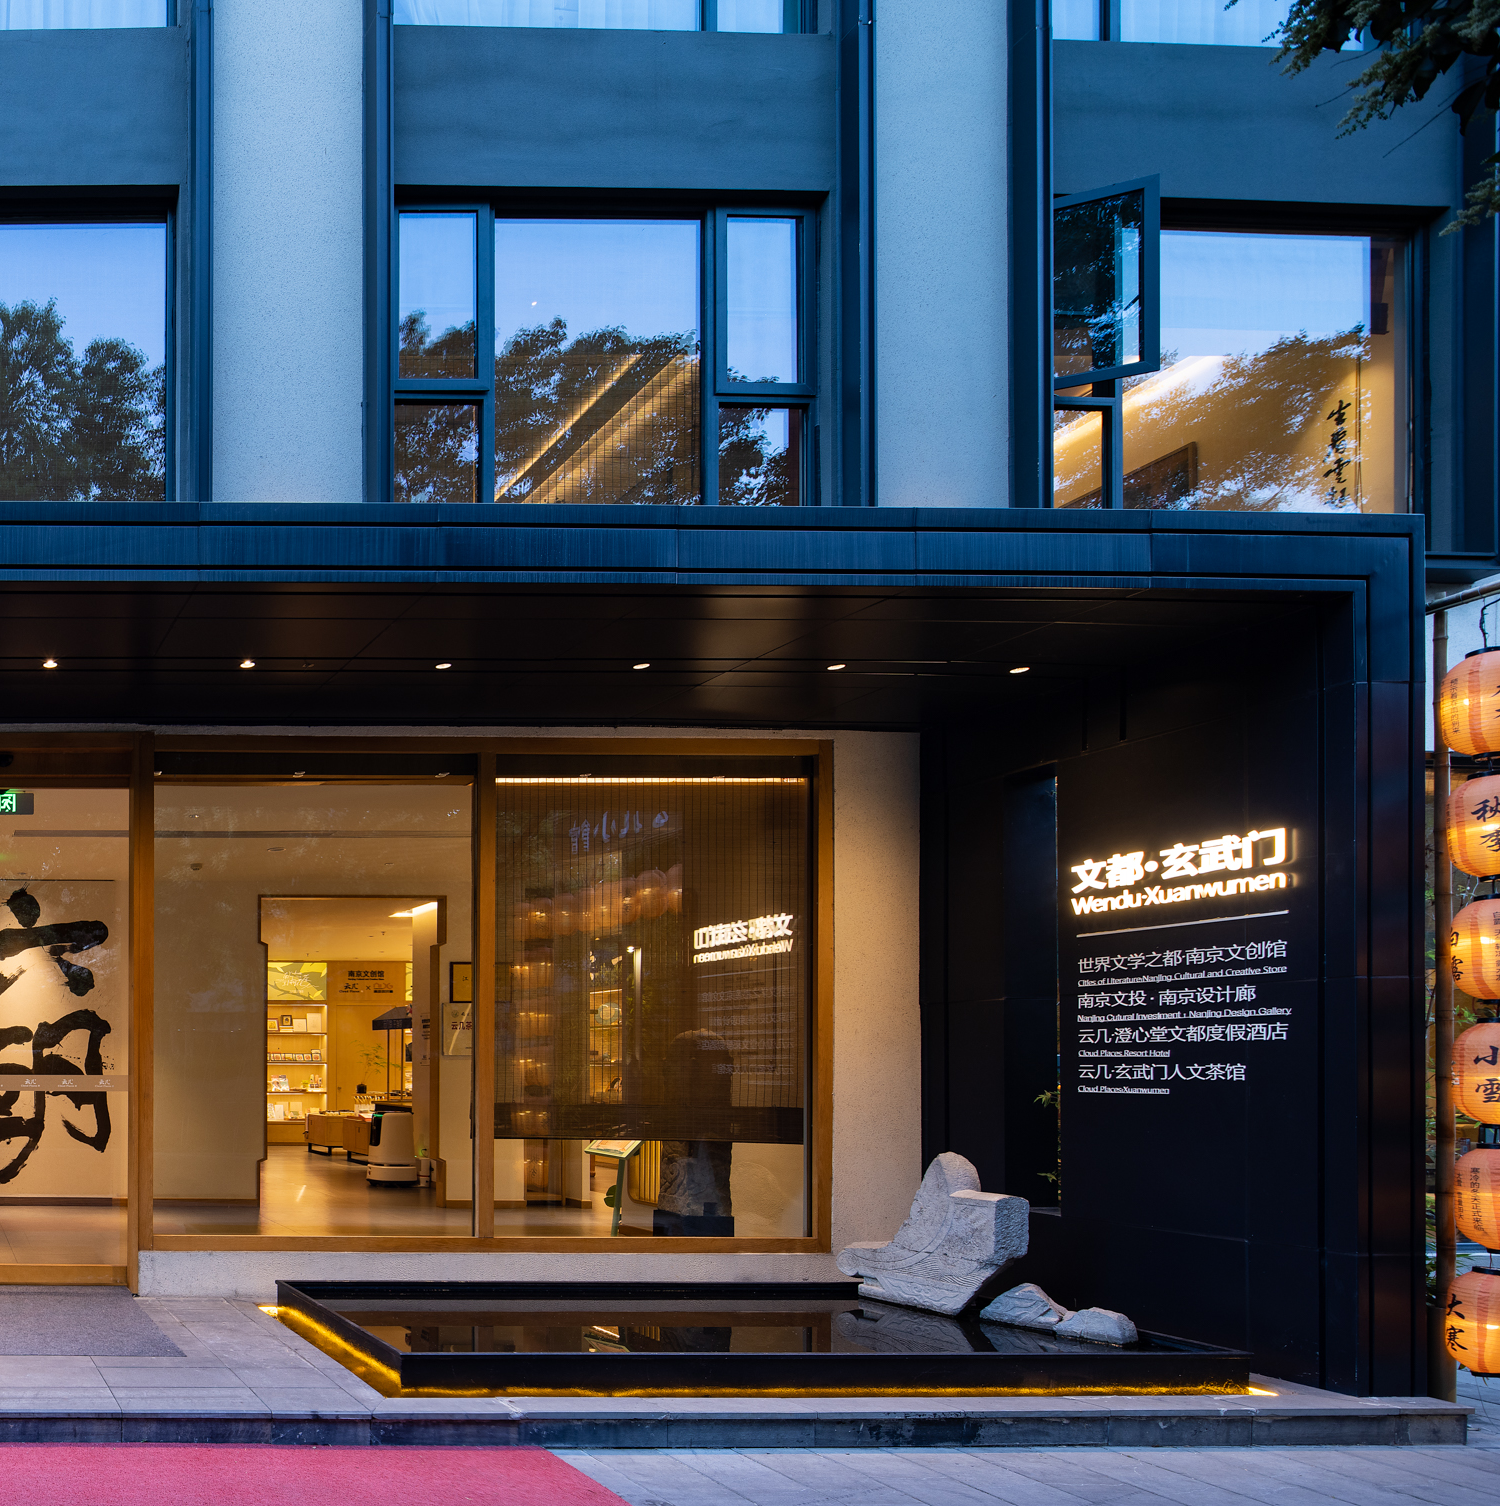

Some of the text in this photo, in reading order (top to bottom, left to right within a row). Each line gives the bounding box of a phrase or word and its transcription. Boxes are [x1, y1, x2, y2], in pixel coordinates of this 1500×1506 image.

[1070, 827, 1287, 894] 文都·玄武门
[1078, 940, 1287, 974] 世界文学之都·南京文创馆
[1174, 970, 1206, 981] Cultural
[1207, 969, 1224, 979] and
[1225, 967, 1261, 977] Creative
[1263, 965, 1287, 974] Store
[1077, 1014, 1105, 1023] Nanjing
[1136, 1011, 1181, 1020] Investment
[1188, 1010, 1222, 1018] Nanjing
[1224, 1008, 1256, 1017] Design
[1258, 1007, 1292, 1016] Gallery
[1078, 1022, 1288, 1044] 云几·澄心堂文都度假酒店
[1078, 1049, 1171, 1057] Cloud Places Resort Hotel
[1078, 1063, 1246, 1081] 云几·玄武门人文茶馆
[1077, 1085, 1099, 1093] Cloud
[1446, 1293, 1468, 1352] 大寒
